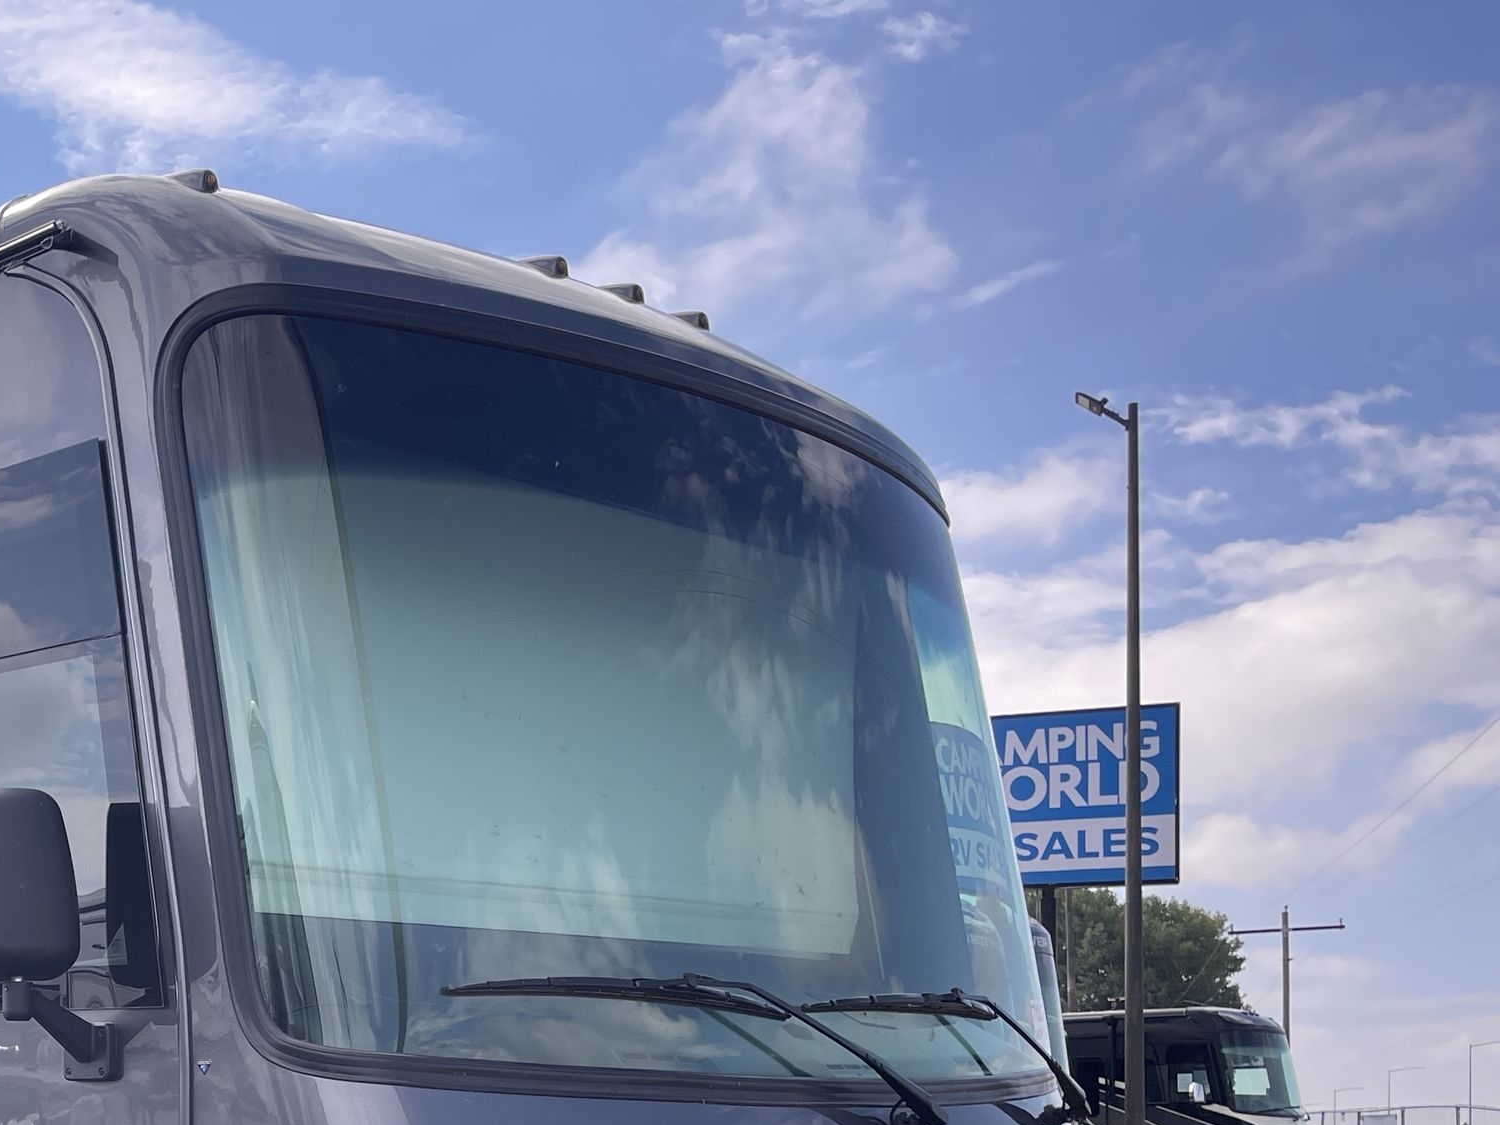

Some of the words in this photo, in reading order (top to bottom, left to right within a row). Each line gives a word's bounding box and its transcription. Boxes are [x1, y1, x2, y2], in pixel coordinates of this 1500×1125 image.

[999, 719, 1161, 767] MPING
[1001, 760, 1160, 812] ORLD
[1014, 826, 1159, 862] SALES
